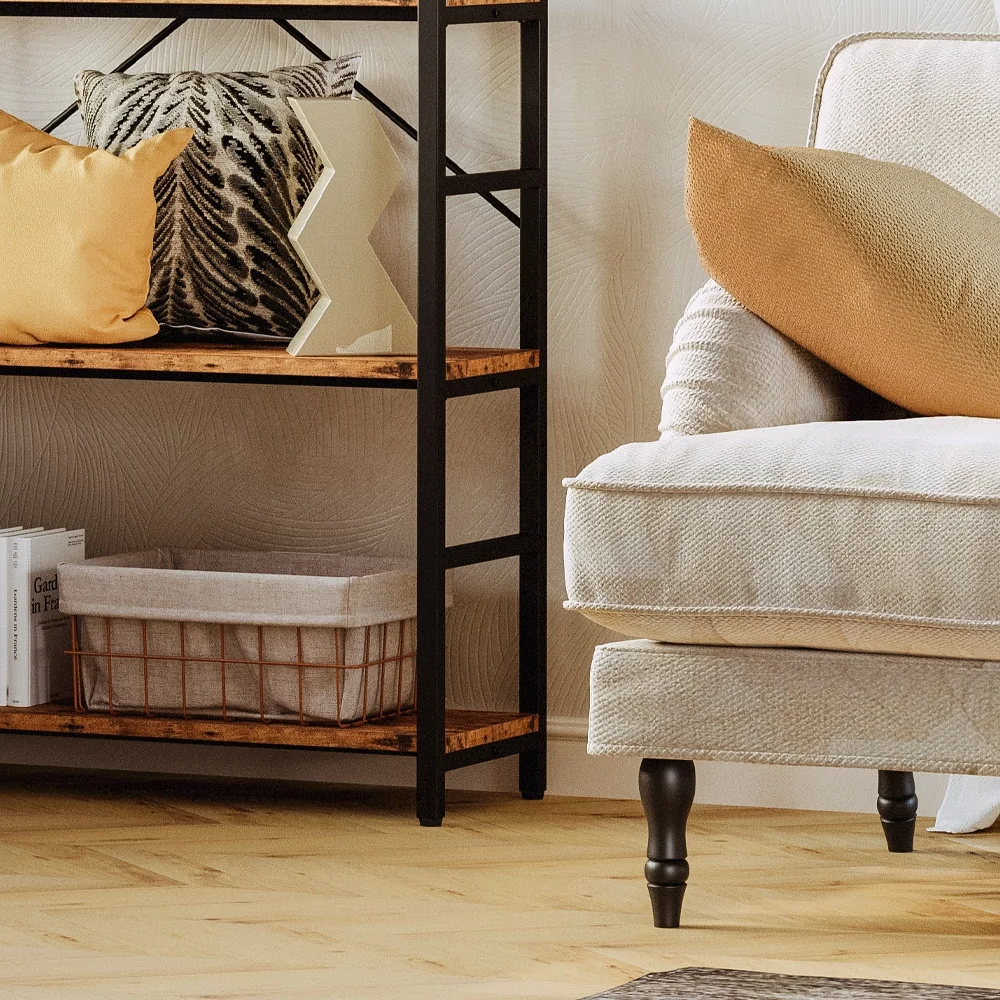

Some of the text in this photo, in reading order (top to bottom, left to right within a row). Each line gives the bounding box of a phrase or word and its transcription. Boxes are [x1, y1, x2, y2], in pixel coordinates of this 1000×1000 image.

[34, 573, 59, 594] Gard
[32, 595, 59, 614] in Fra
